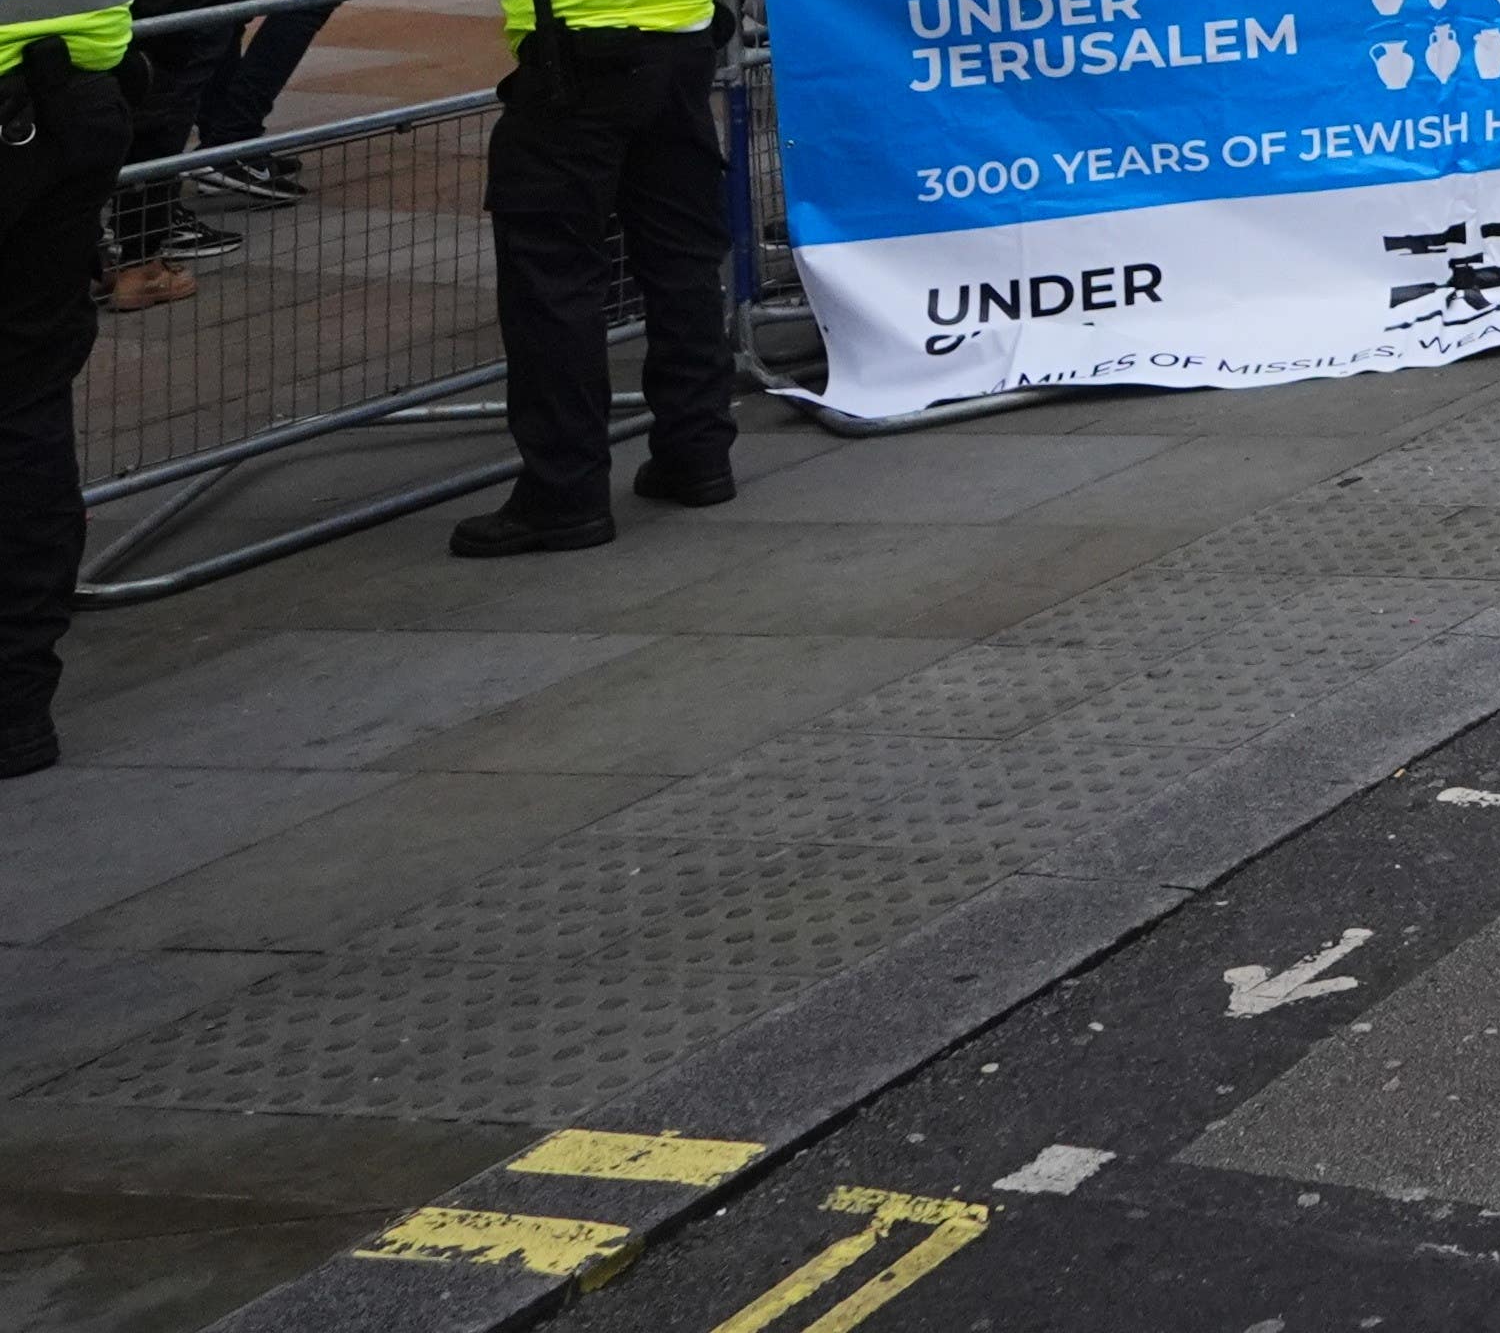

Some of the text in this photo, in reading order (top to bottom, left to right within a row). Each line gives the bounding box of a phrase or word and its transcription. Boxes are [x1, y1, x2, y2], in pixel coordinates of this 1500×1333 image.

[908, 13, 1299, 93] JERUSALEM
[917, 157, 1040, 204] 3000
[1052, 139, 1210, 185] YEARS
[1221, 131, 1287, 168] OF
[1299, 111, 1469, 160] JEWISH
[925, 262, 1163, 326] UNDER
[1149, 351, 1209, 370] OF
[1216, 342, 1403, 377] MISSILES,
